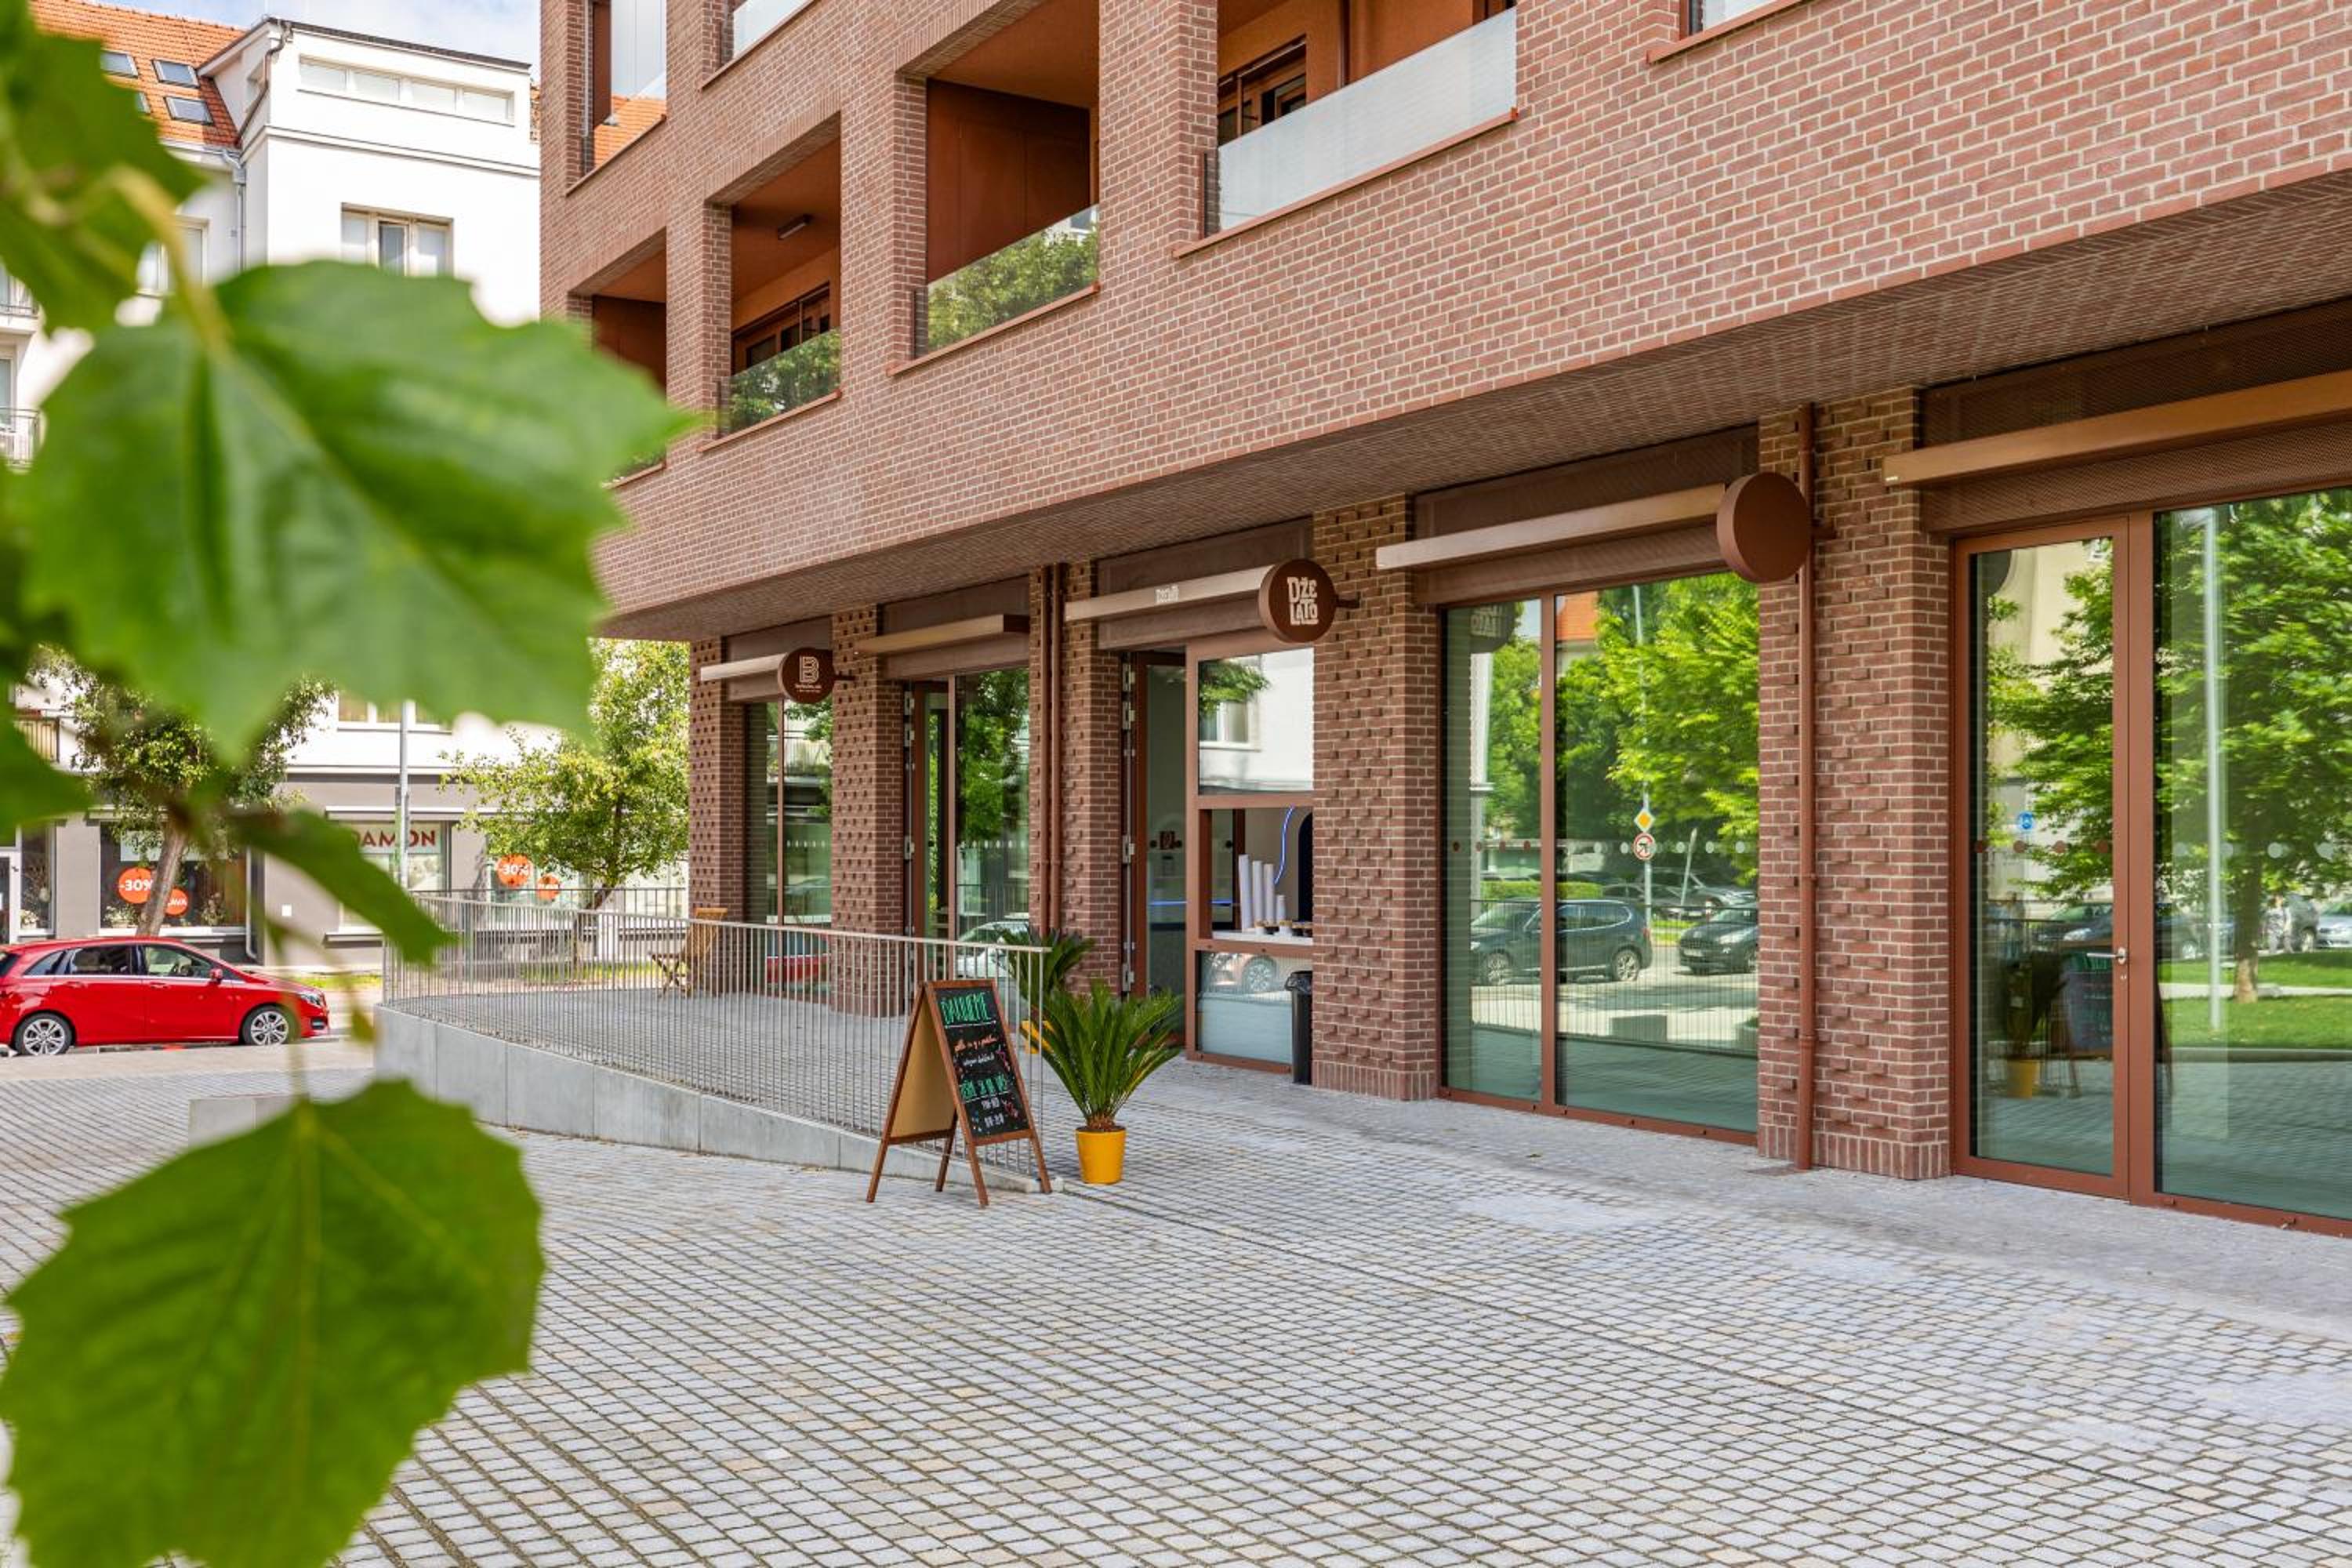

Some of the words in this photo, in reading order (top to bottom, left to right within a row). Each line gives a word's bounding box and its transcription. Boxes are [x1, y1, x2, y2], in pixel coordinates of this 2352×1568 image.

[1287, 576, 1318, 603] DŽE
[1289, 598, 1319, 626] LATO
[799, 655, 819, 683] B
